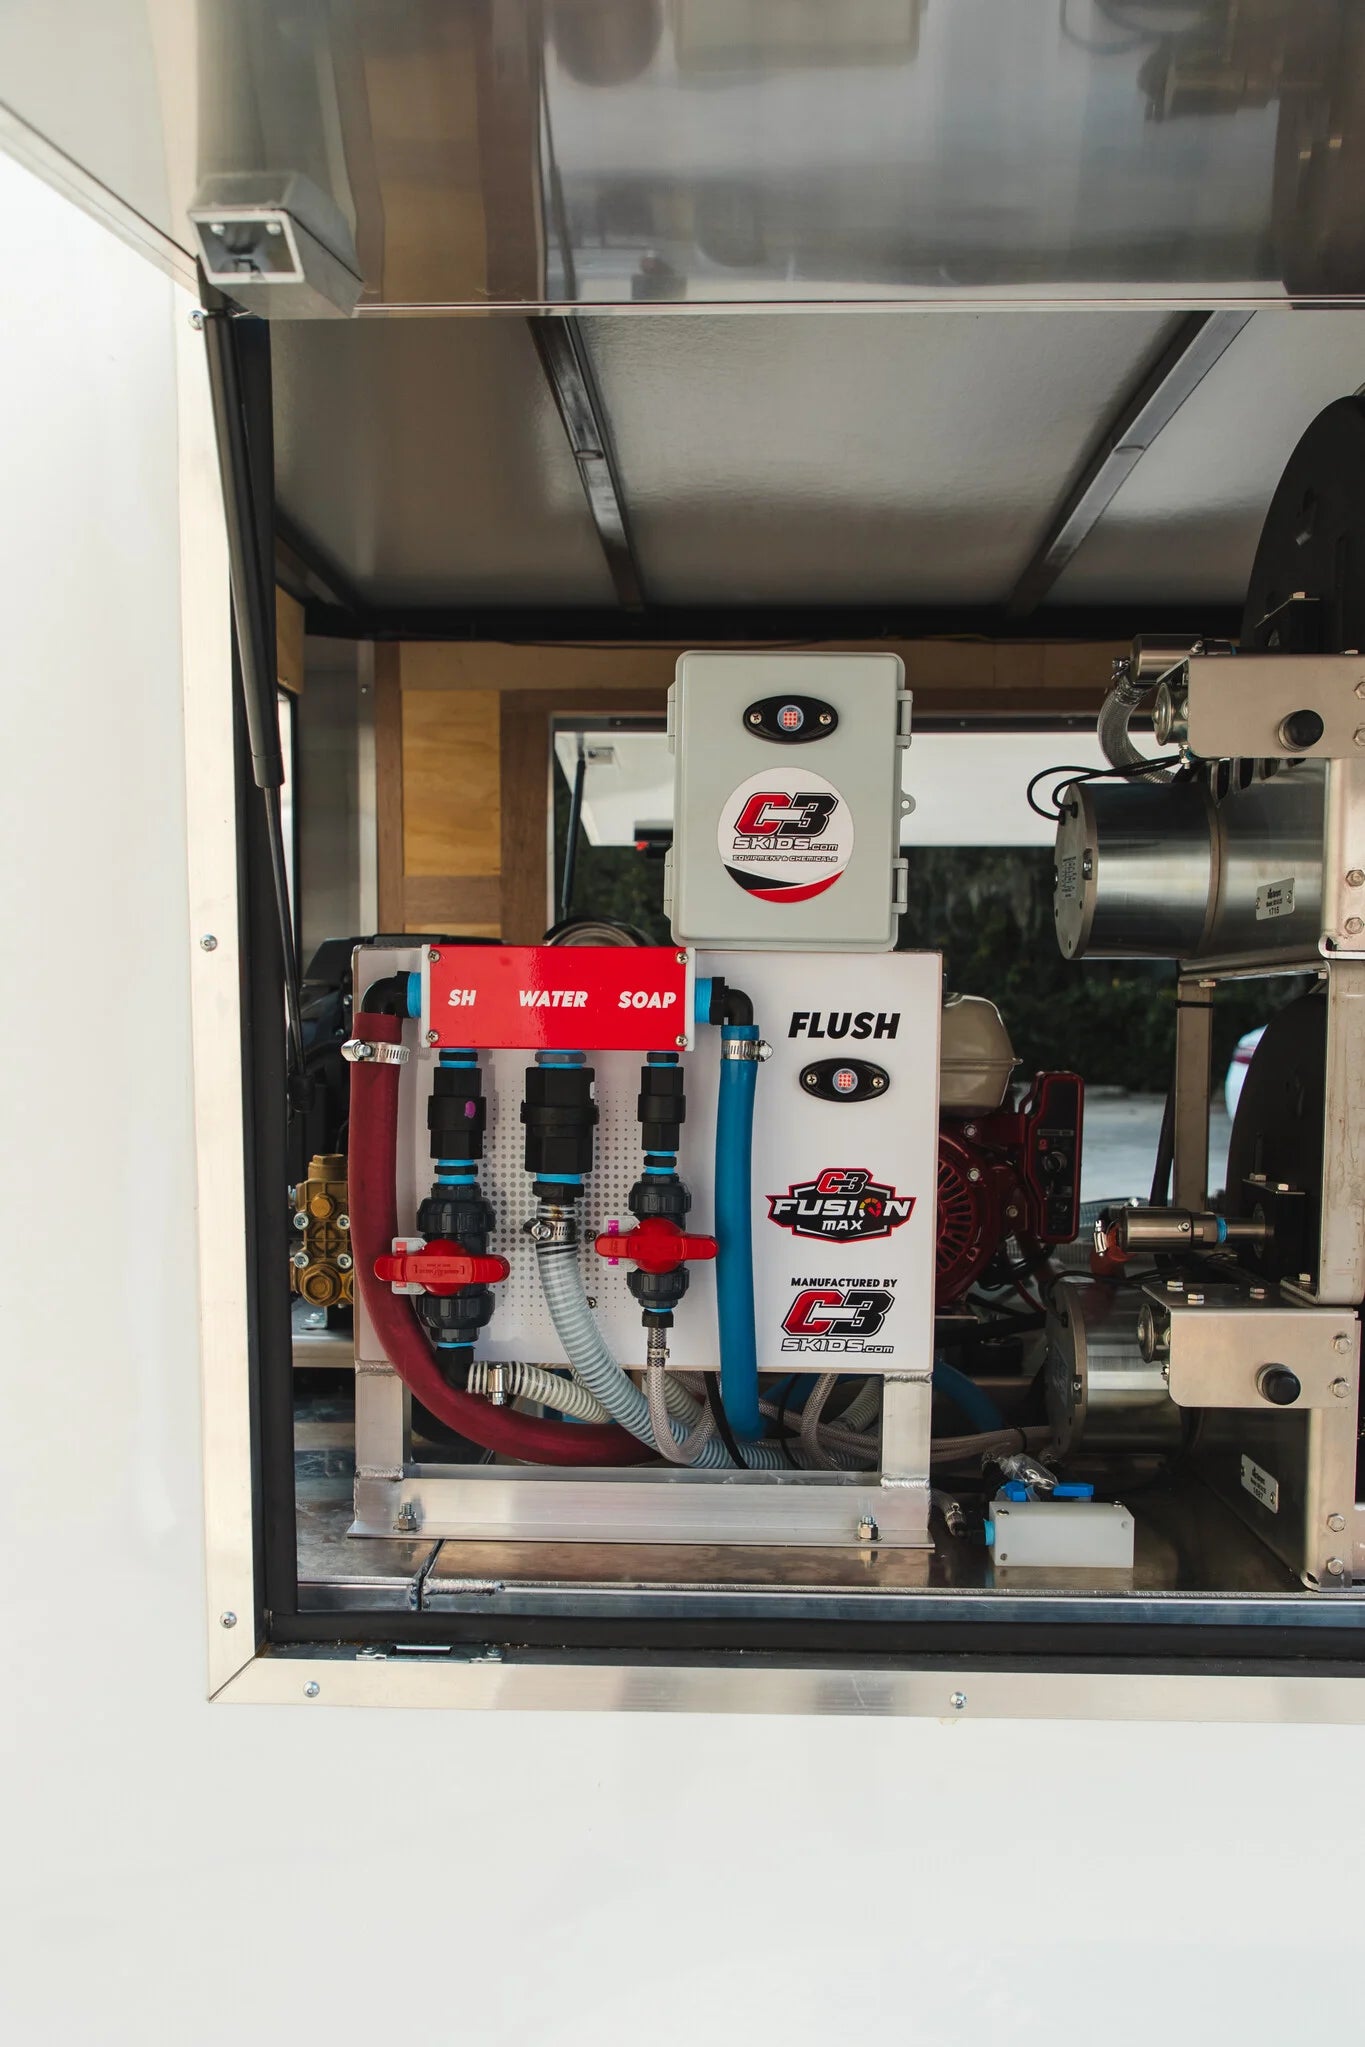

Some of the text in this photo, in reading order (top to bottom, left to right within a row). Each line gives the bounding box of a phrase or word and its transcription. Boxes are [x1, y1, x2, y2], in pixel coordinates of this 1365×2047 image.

[734, 792, 839, 837] C3
[732, 854, 781, 862] EQUIPMENT
[788, 855, 838, 863] CHEMICALS
[448, 989, 677, 1009] SH WATER SOAP
[788, 1012, 901, 1039] FLUSH
[817, 1171, 869, 1195] C3
[773, 1197, 911, 1217] FUSION
[821, 1219, 864, 1231] MAX
[790, 1277, 897, 1288] MANUFACTURED BY
[781, 1289, 895, 1337] C3
